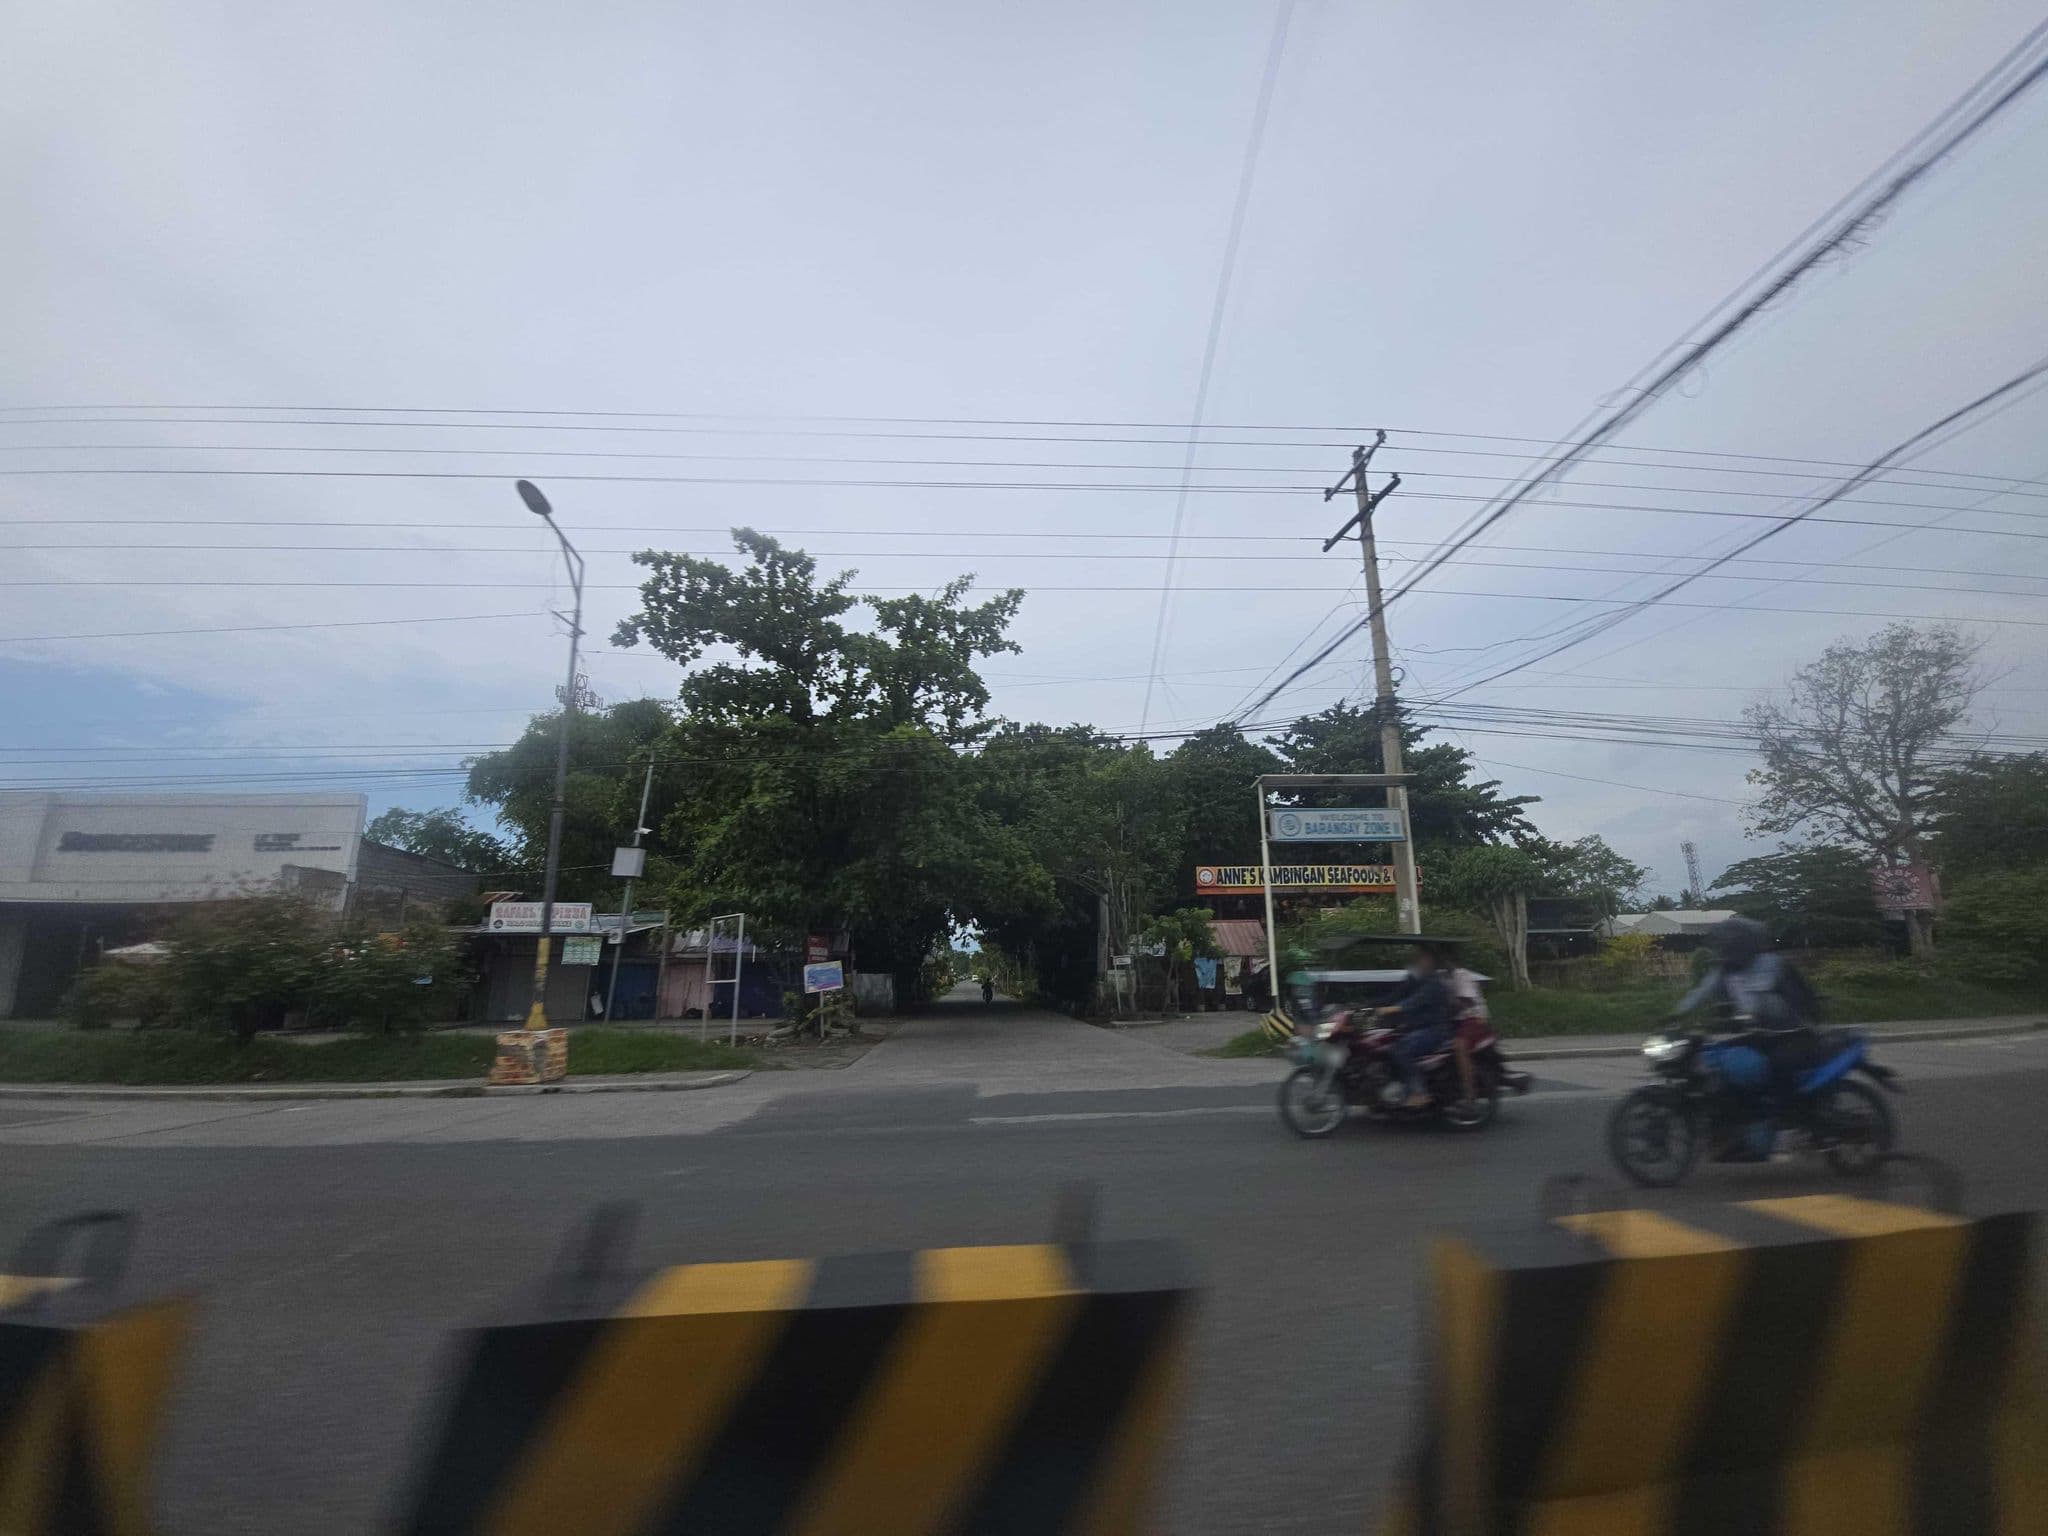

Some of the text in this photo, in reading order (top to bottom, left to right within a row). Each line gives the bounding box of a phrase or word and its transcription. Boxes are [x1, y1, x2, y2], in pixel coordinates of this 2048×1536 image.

[1305, 822, 1359, 834] BARANGAY
[1364, 822, 1391, 834] ZONE
[1216, 867, 1256, 884] ANNE'S
[1328, 866, 1381, 883] SEAFOODS
[1383, 868, 1391, 882] &
